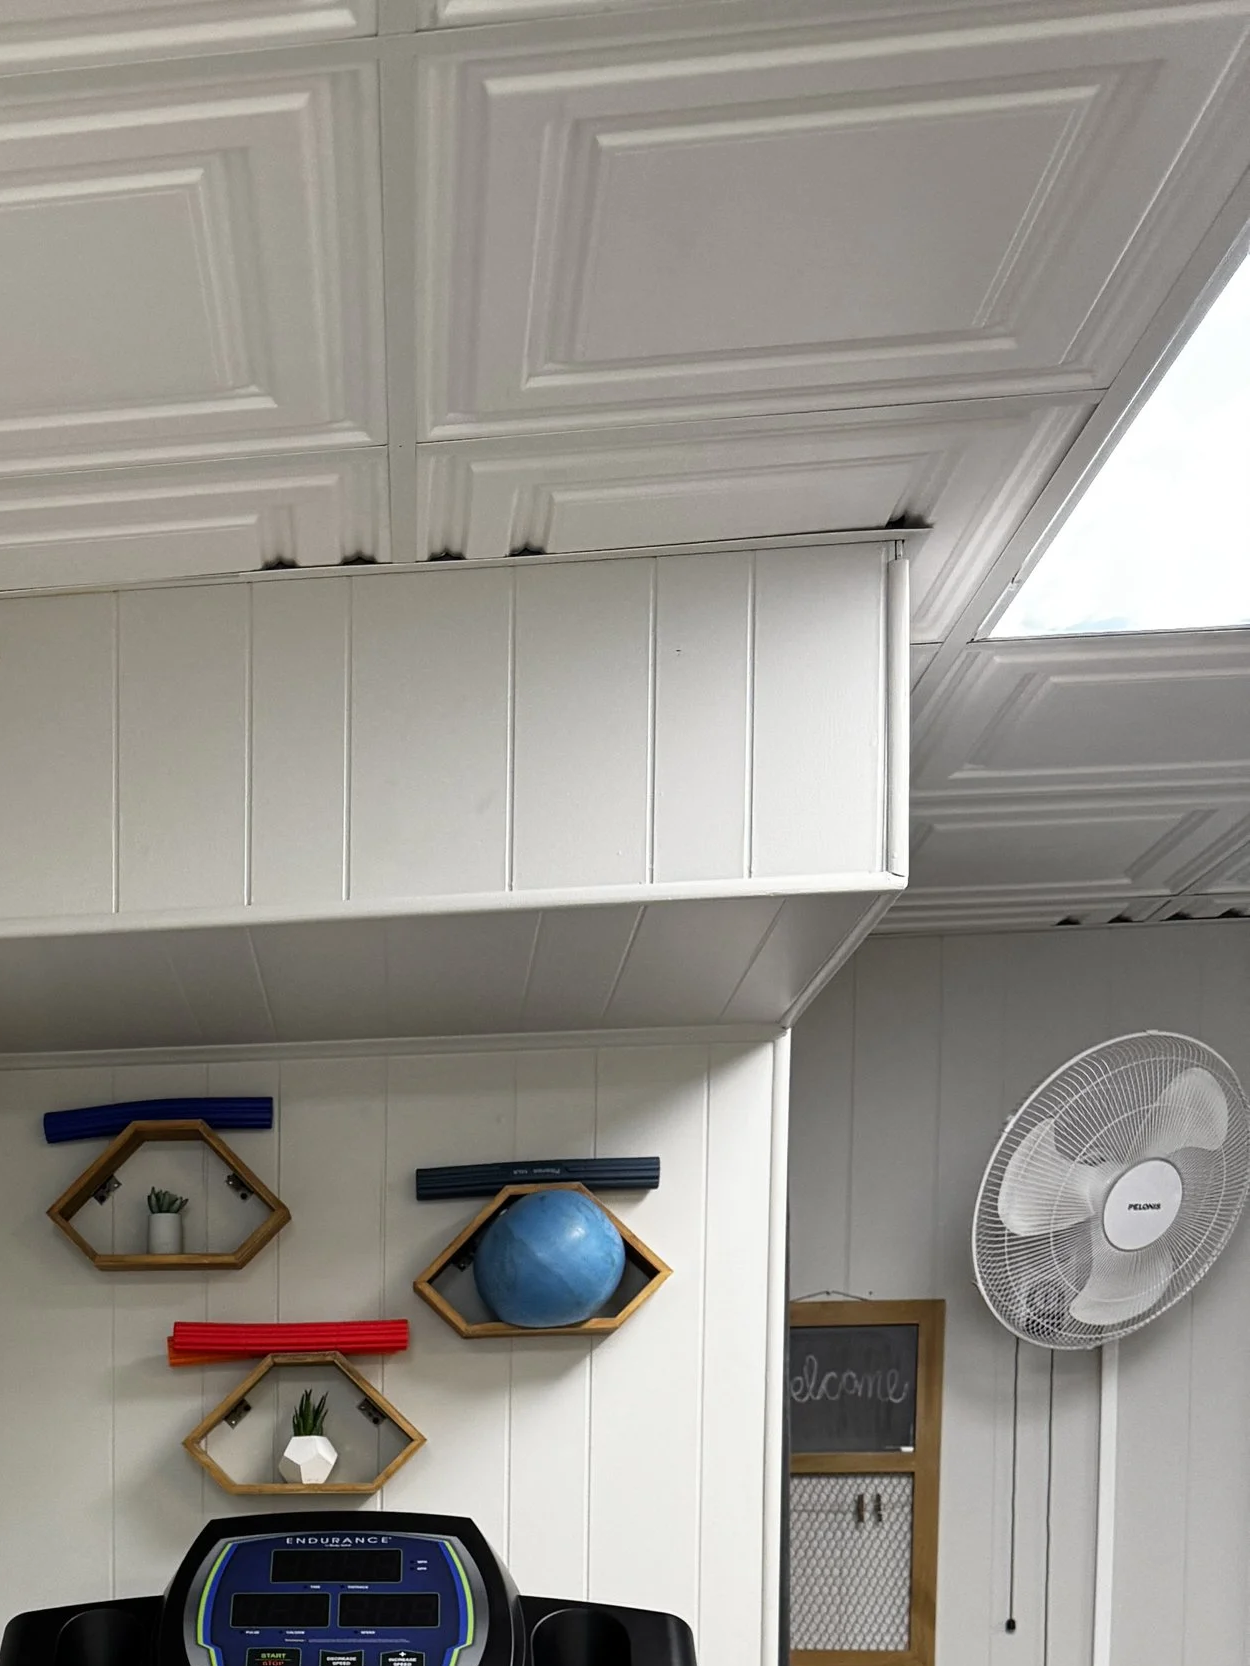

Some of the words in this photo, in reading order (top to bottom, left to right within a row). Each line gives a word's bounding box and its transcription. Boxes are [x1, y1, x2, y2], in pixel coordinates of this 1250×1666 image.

[1127, 1203, 1162, 1211] PELONIS
[790, 1354, 909, 1404] elcome
[286, 1536, 390, 1545] ENDURANCE
